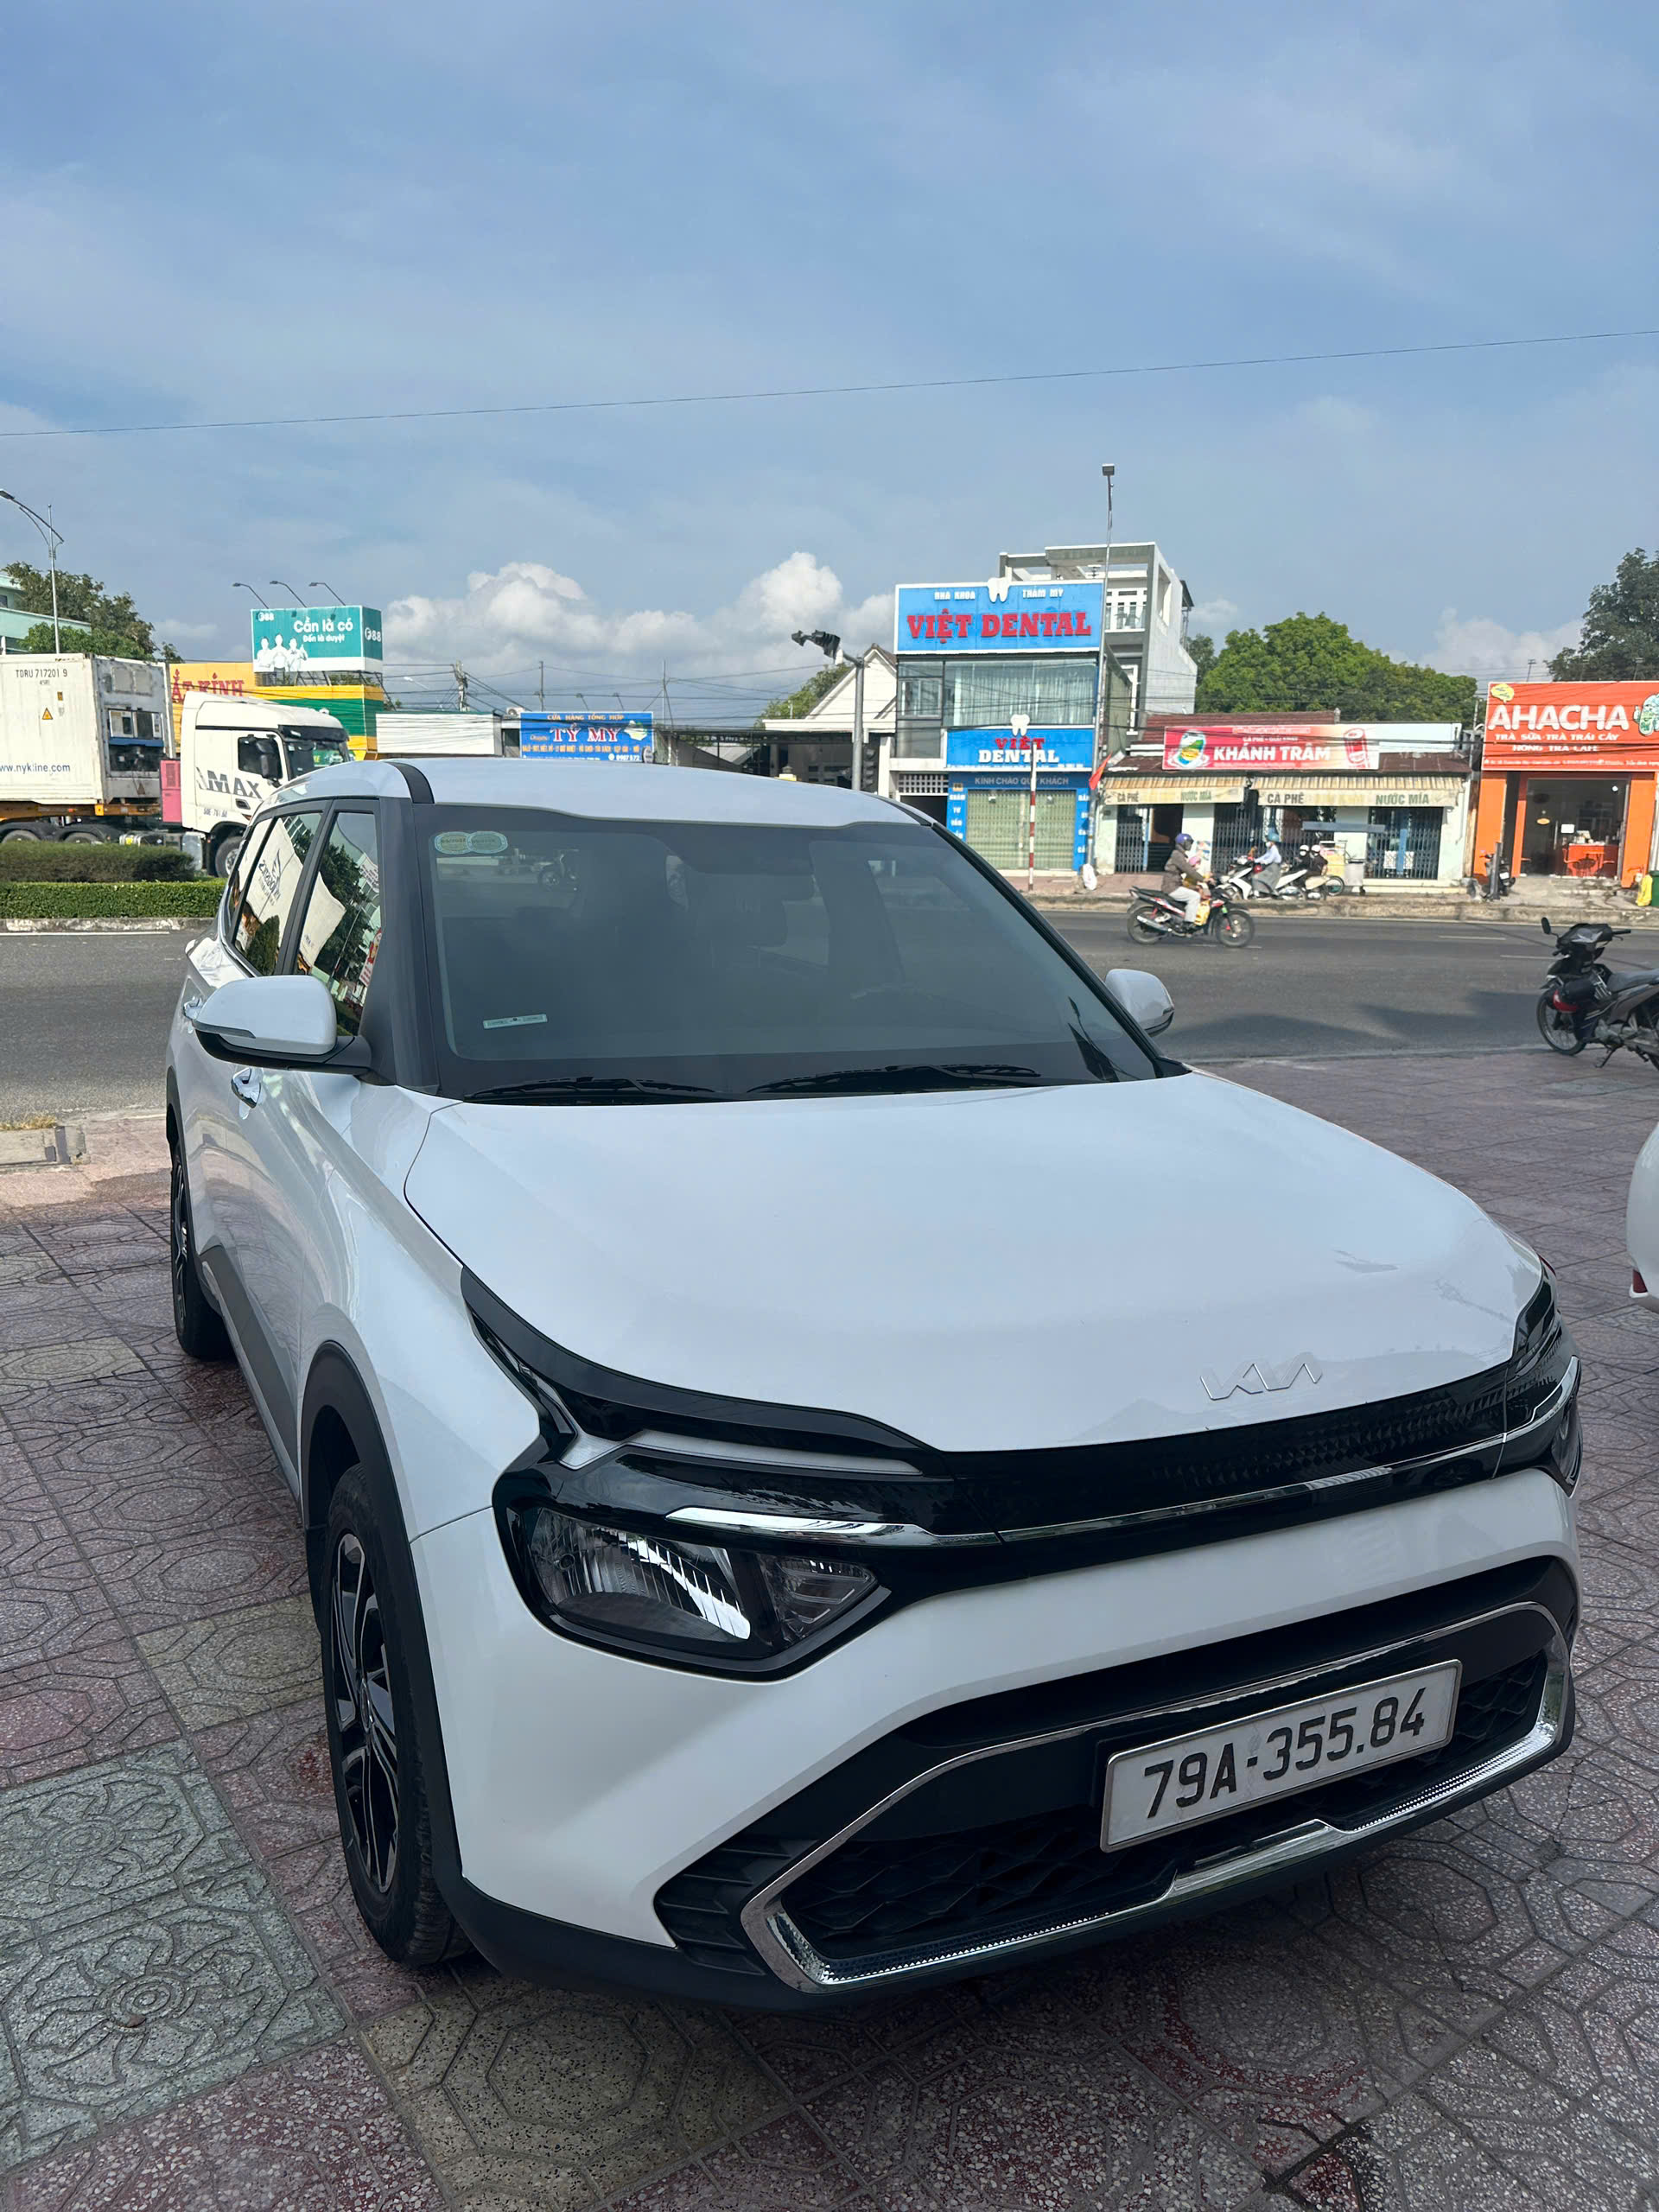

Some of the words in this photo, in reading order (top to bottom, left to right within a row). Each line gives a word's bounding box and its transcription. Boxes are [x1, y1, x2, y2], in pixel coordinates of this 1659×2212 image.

[293, 616, 320, 633] Cần
[322, 618, 334, 632] là
[337, 617, 353, 632] có
[906, 607, 972, 644] VIỆT
[981, 611, 1092, 638] DENTAL
[62, 668, 68, 677] 9
[1487, 704, 1630, 731] AHACHA
[1495, 731, 1516, 741] TRÀ
[1521, 731, 1541, 741] SỮA
[1546, 731, 1567, 741] TRÀ
[1570, 731, 1595, 741] TRÁI
[977, 748, 1059, 763] DENTAL
[1213, 742, 1275, 761] KHÁNH
[1279, 742, 1332, 761] TRÂM
[207, 769, 263, 800] MAX
[975, 776, 995, 785] KÍNH
[995, 776, 1019, 785] CHÀO
[1039, 776, 1069, 785] KHÁCH
[1267, 793, 1281, 804] CÀ
[1284, 792, 1305, 804] PHÊ
[1375, 793, 1405, 805] NƯỚC
[1408, 793, 1429, 805] MÍA
[1142, 1687, 1427, 1820] 79A-355.84
